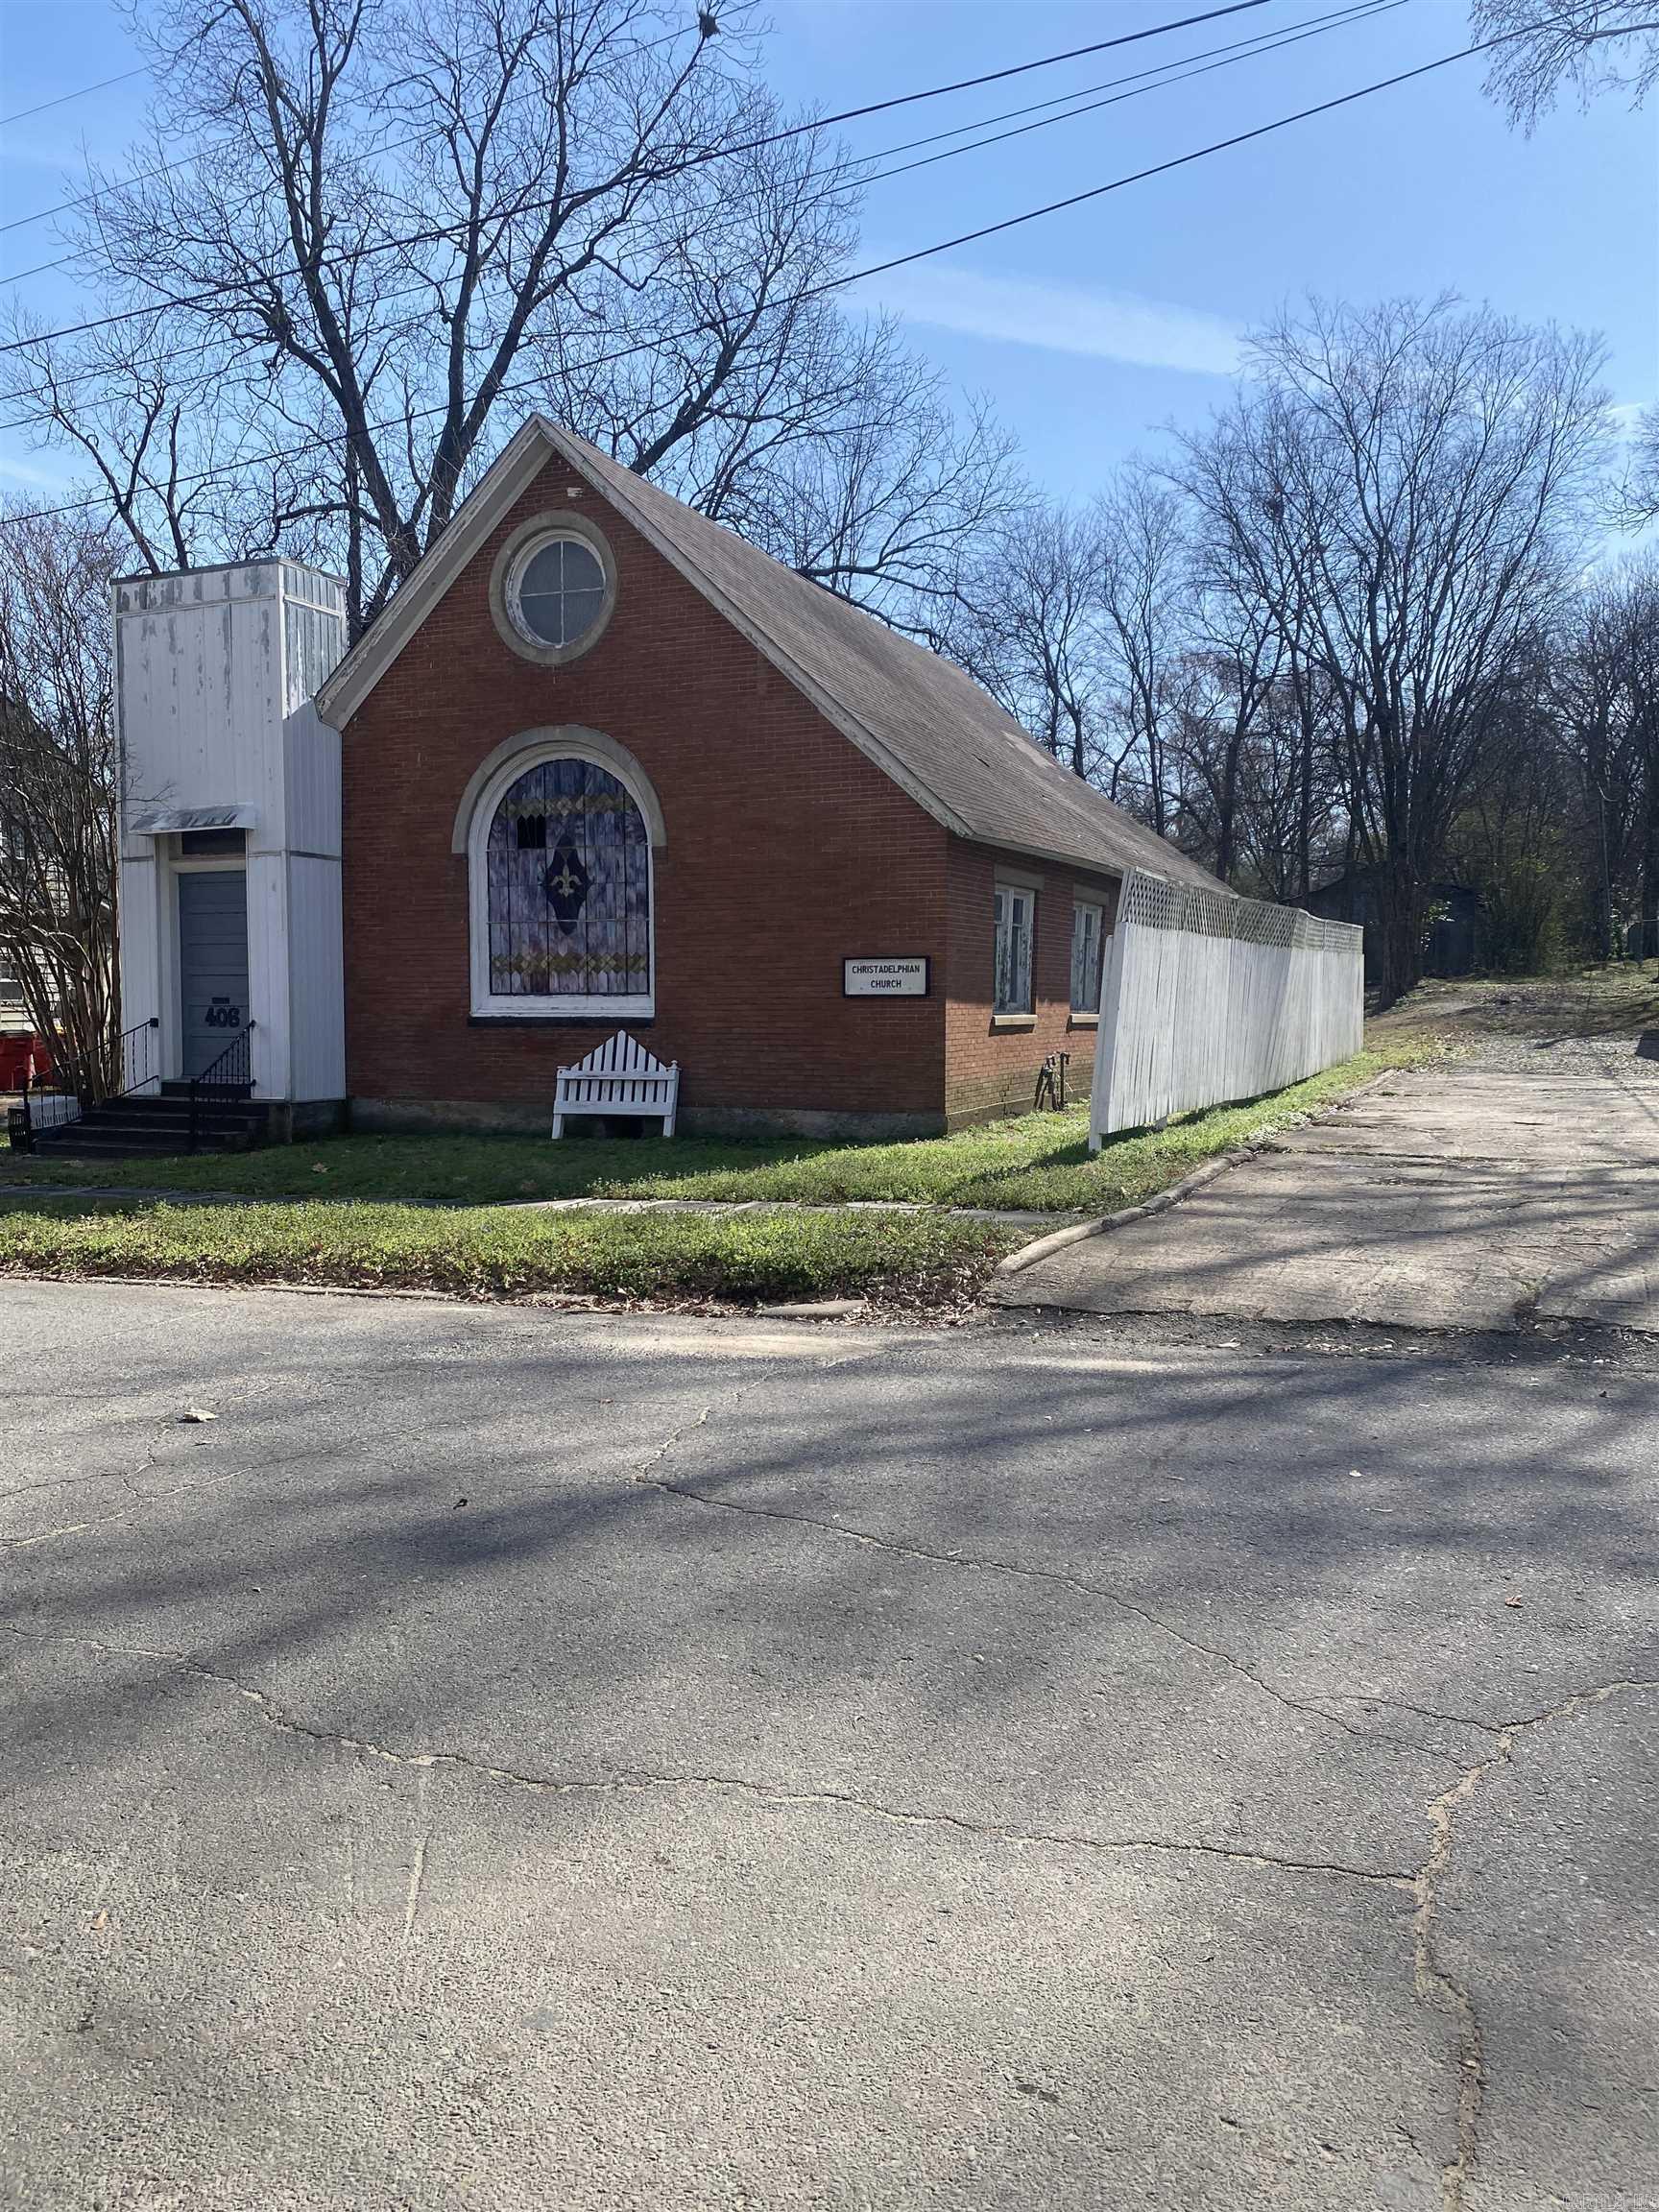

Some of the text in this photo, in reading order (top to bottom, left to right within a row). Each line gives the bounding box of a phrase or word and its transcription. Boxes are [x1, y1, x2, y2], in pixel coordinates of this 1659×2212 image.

[852, 965, 921, 974] CHRISTADELPHIAN
[870, 979, 902, 988] CHURCH
[204, 1007, 240, 1027] 406
